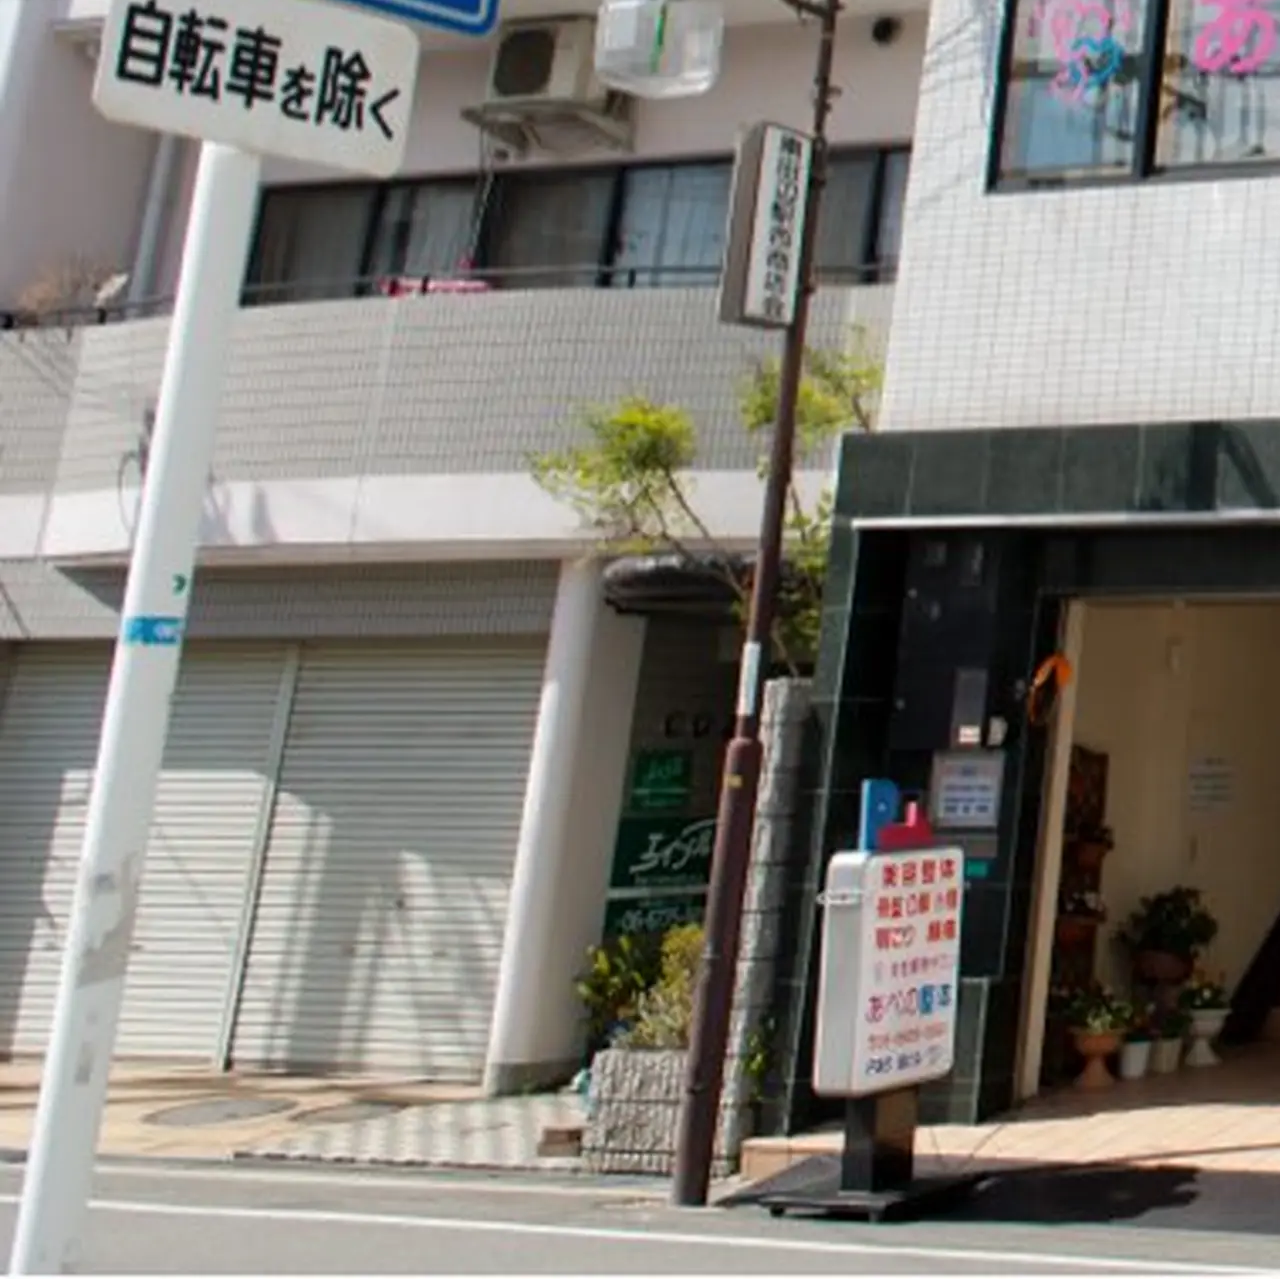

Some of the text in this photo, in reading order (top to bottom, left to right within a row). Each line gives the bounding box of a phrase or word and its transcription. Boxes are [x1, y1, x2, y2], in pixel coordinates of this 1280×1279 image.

[864, 983, 953, 1023] あべの整体
